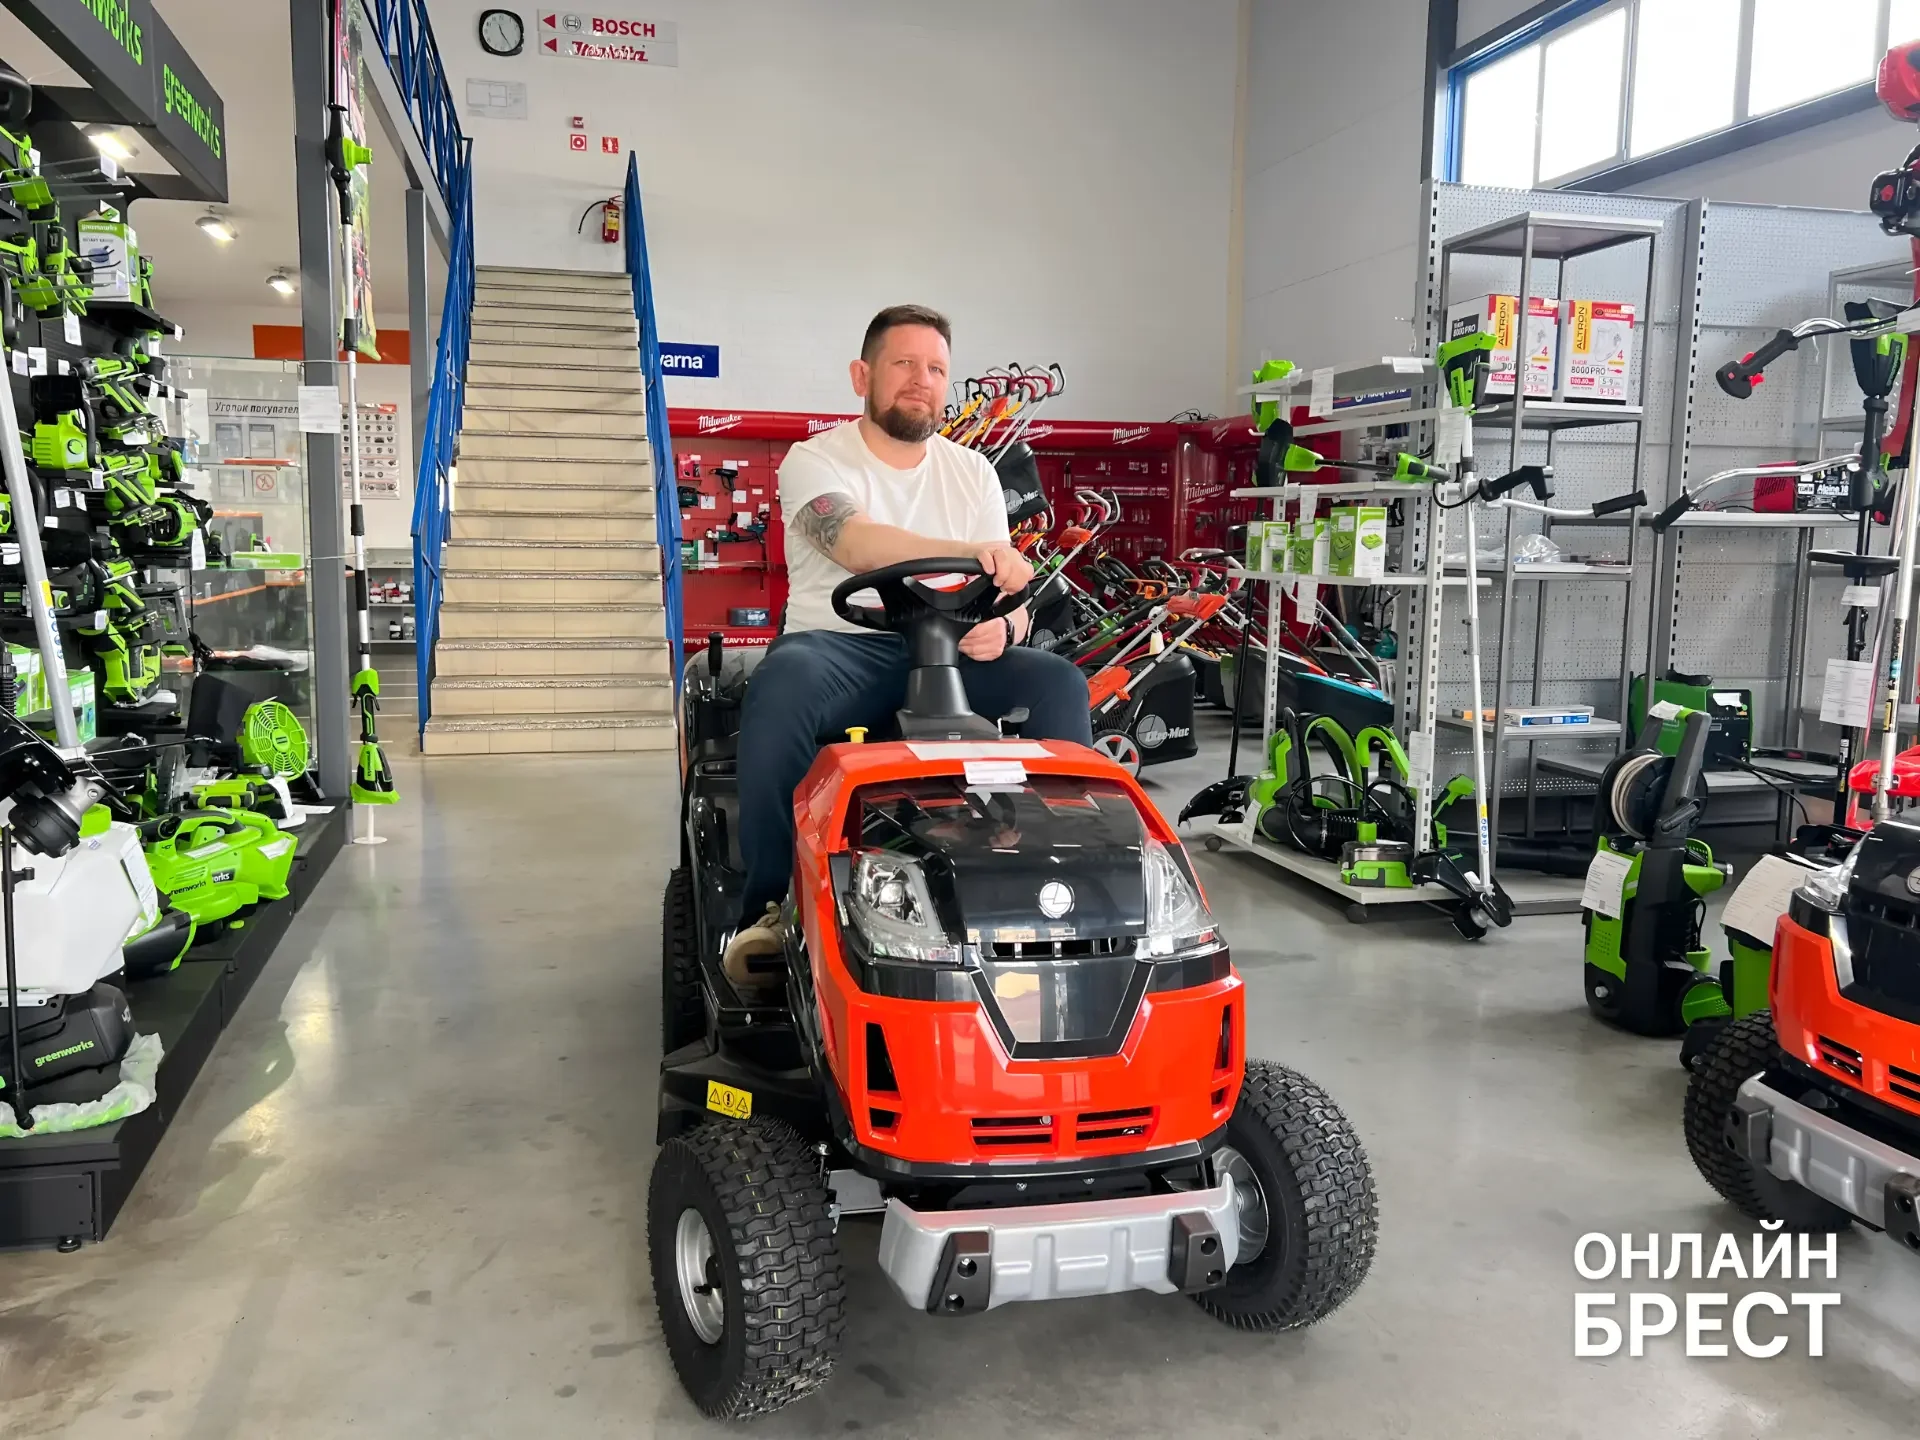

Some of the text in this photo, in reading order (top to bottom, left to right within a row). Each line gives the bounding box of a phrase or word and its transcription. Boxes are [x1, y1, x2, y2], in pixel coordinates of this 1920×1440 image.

[79, 0, 143, 65] works
[592, 17, 655, 37] BOSCH
[163, 63, 221, 159] greenworks
[1498, 302, 1507, 346] ALTRON
[1576, 306, 1585, 350] ALTRON
[1541, 346, 1549, 356] 4
[1617, 350, 1624, 360] 4
[215, 402, 299, 415] Уголок покупател
[697, 413, 743, 430] Milwaukee
[1112, 425, 1151, 441] Milwaukee
[34, 1040, 95, 1067] greenworks
